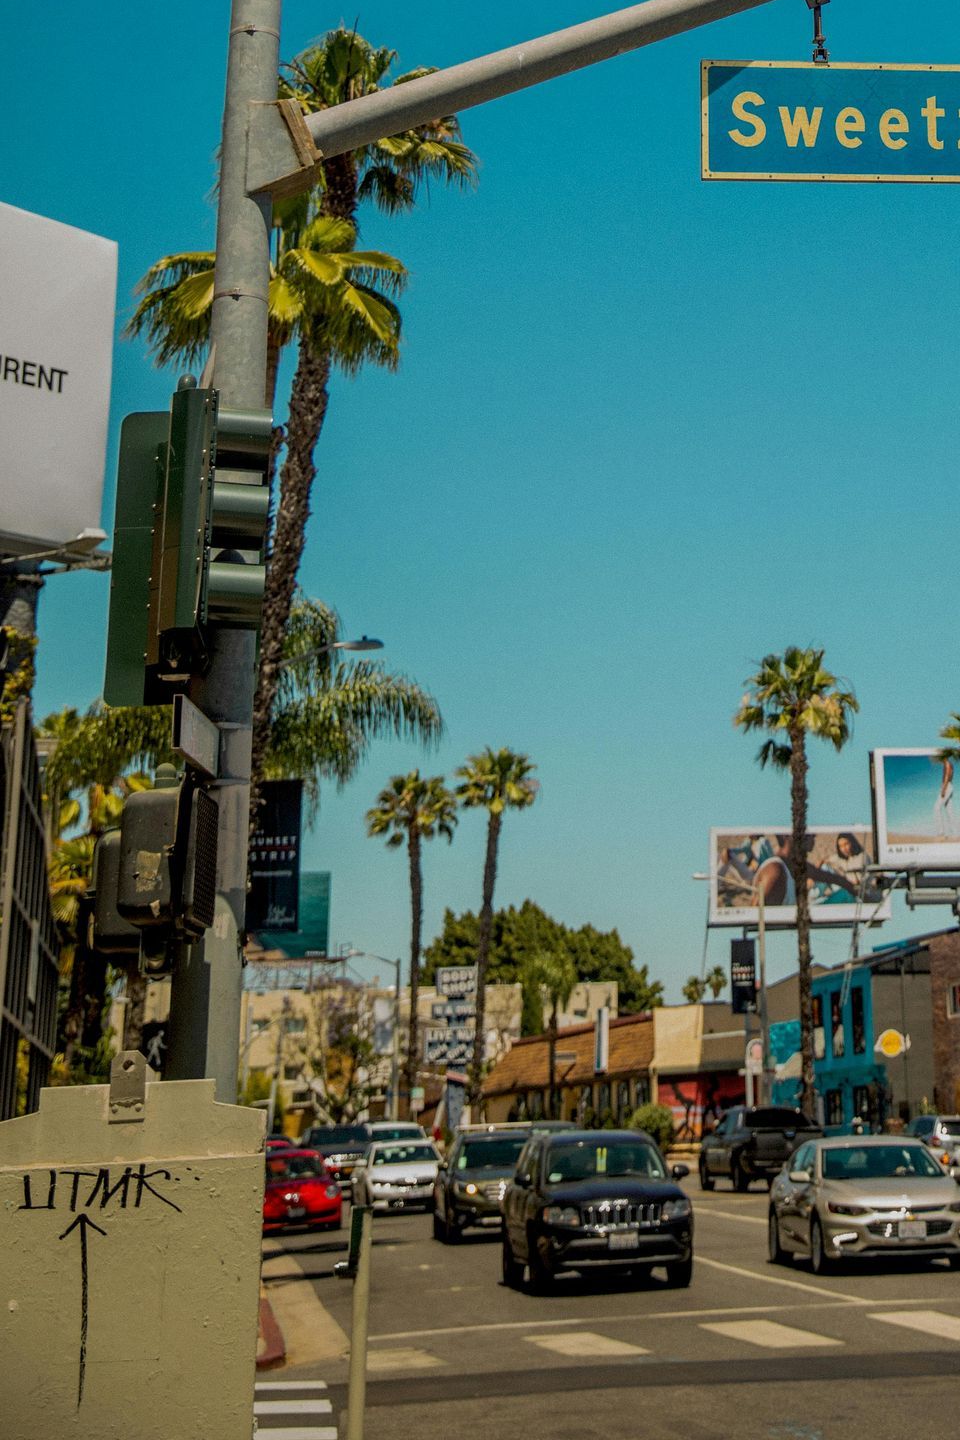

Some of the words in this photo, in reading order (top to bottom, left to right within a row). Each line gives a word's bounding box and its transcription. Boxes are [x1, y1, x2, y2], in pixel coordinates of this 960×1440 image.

[0, 356, 68, 393] RENT
[251, 835, 297, 846] SUNSET
[250, 851, 297, 862] STRIP
[456, 1028, 476, 1041] NU
